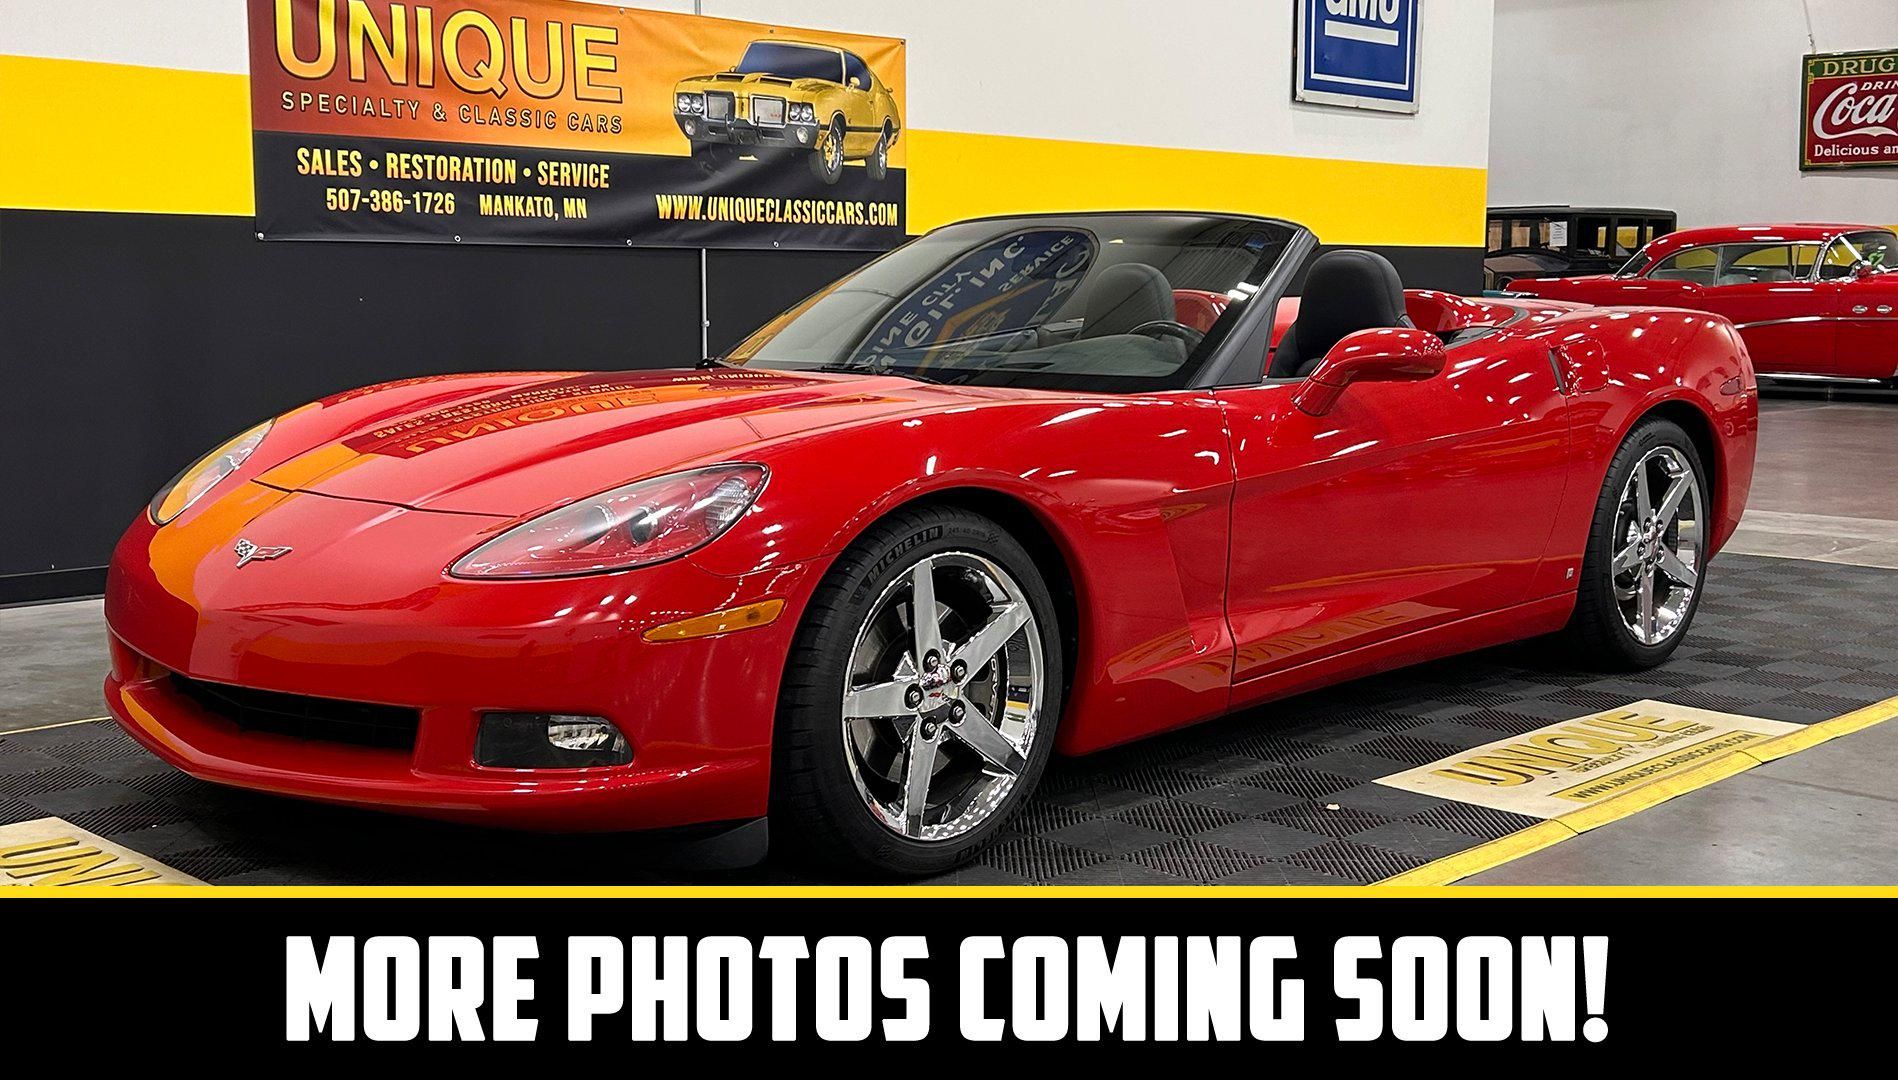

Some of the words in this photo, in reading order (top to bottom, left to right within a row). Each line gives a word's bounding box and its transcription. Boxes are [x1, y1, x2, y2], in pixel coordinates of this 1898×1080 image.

[274, 0, 623, 104] UNIQUE
[1823, 57, 1896, 76] DRUG
[281, 91, 419, 119] SPECIALTY
[432, 103, 447, 122] &
[458, 105, 557, 129] CLASSIC
[567, 115, 623, 134] CARS
[1812, 82, 1897, 140] Coca
[296, 147, 362, 177] SALES
[386, 152, 517, 185] RESTORATION
[537, 161, 610, 189] SERVICE
[1814, 144, 1879, 157] Delicious
[326, 188, 456, 215] 507-386-1726
[479, 194, 559, 221] MANKATO,
[564, 198, 587, 219] MN
[655, 194, 899, 226] WWW.UNIQUECLASSICCARS.COM
[867, 526, 942, 584] MICHELIN
[1432, 710, 1700, 787] UNIQUE
